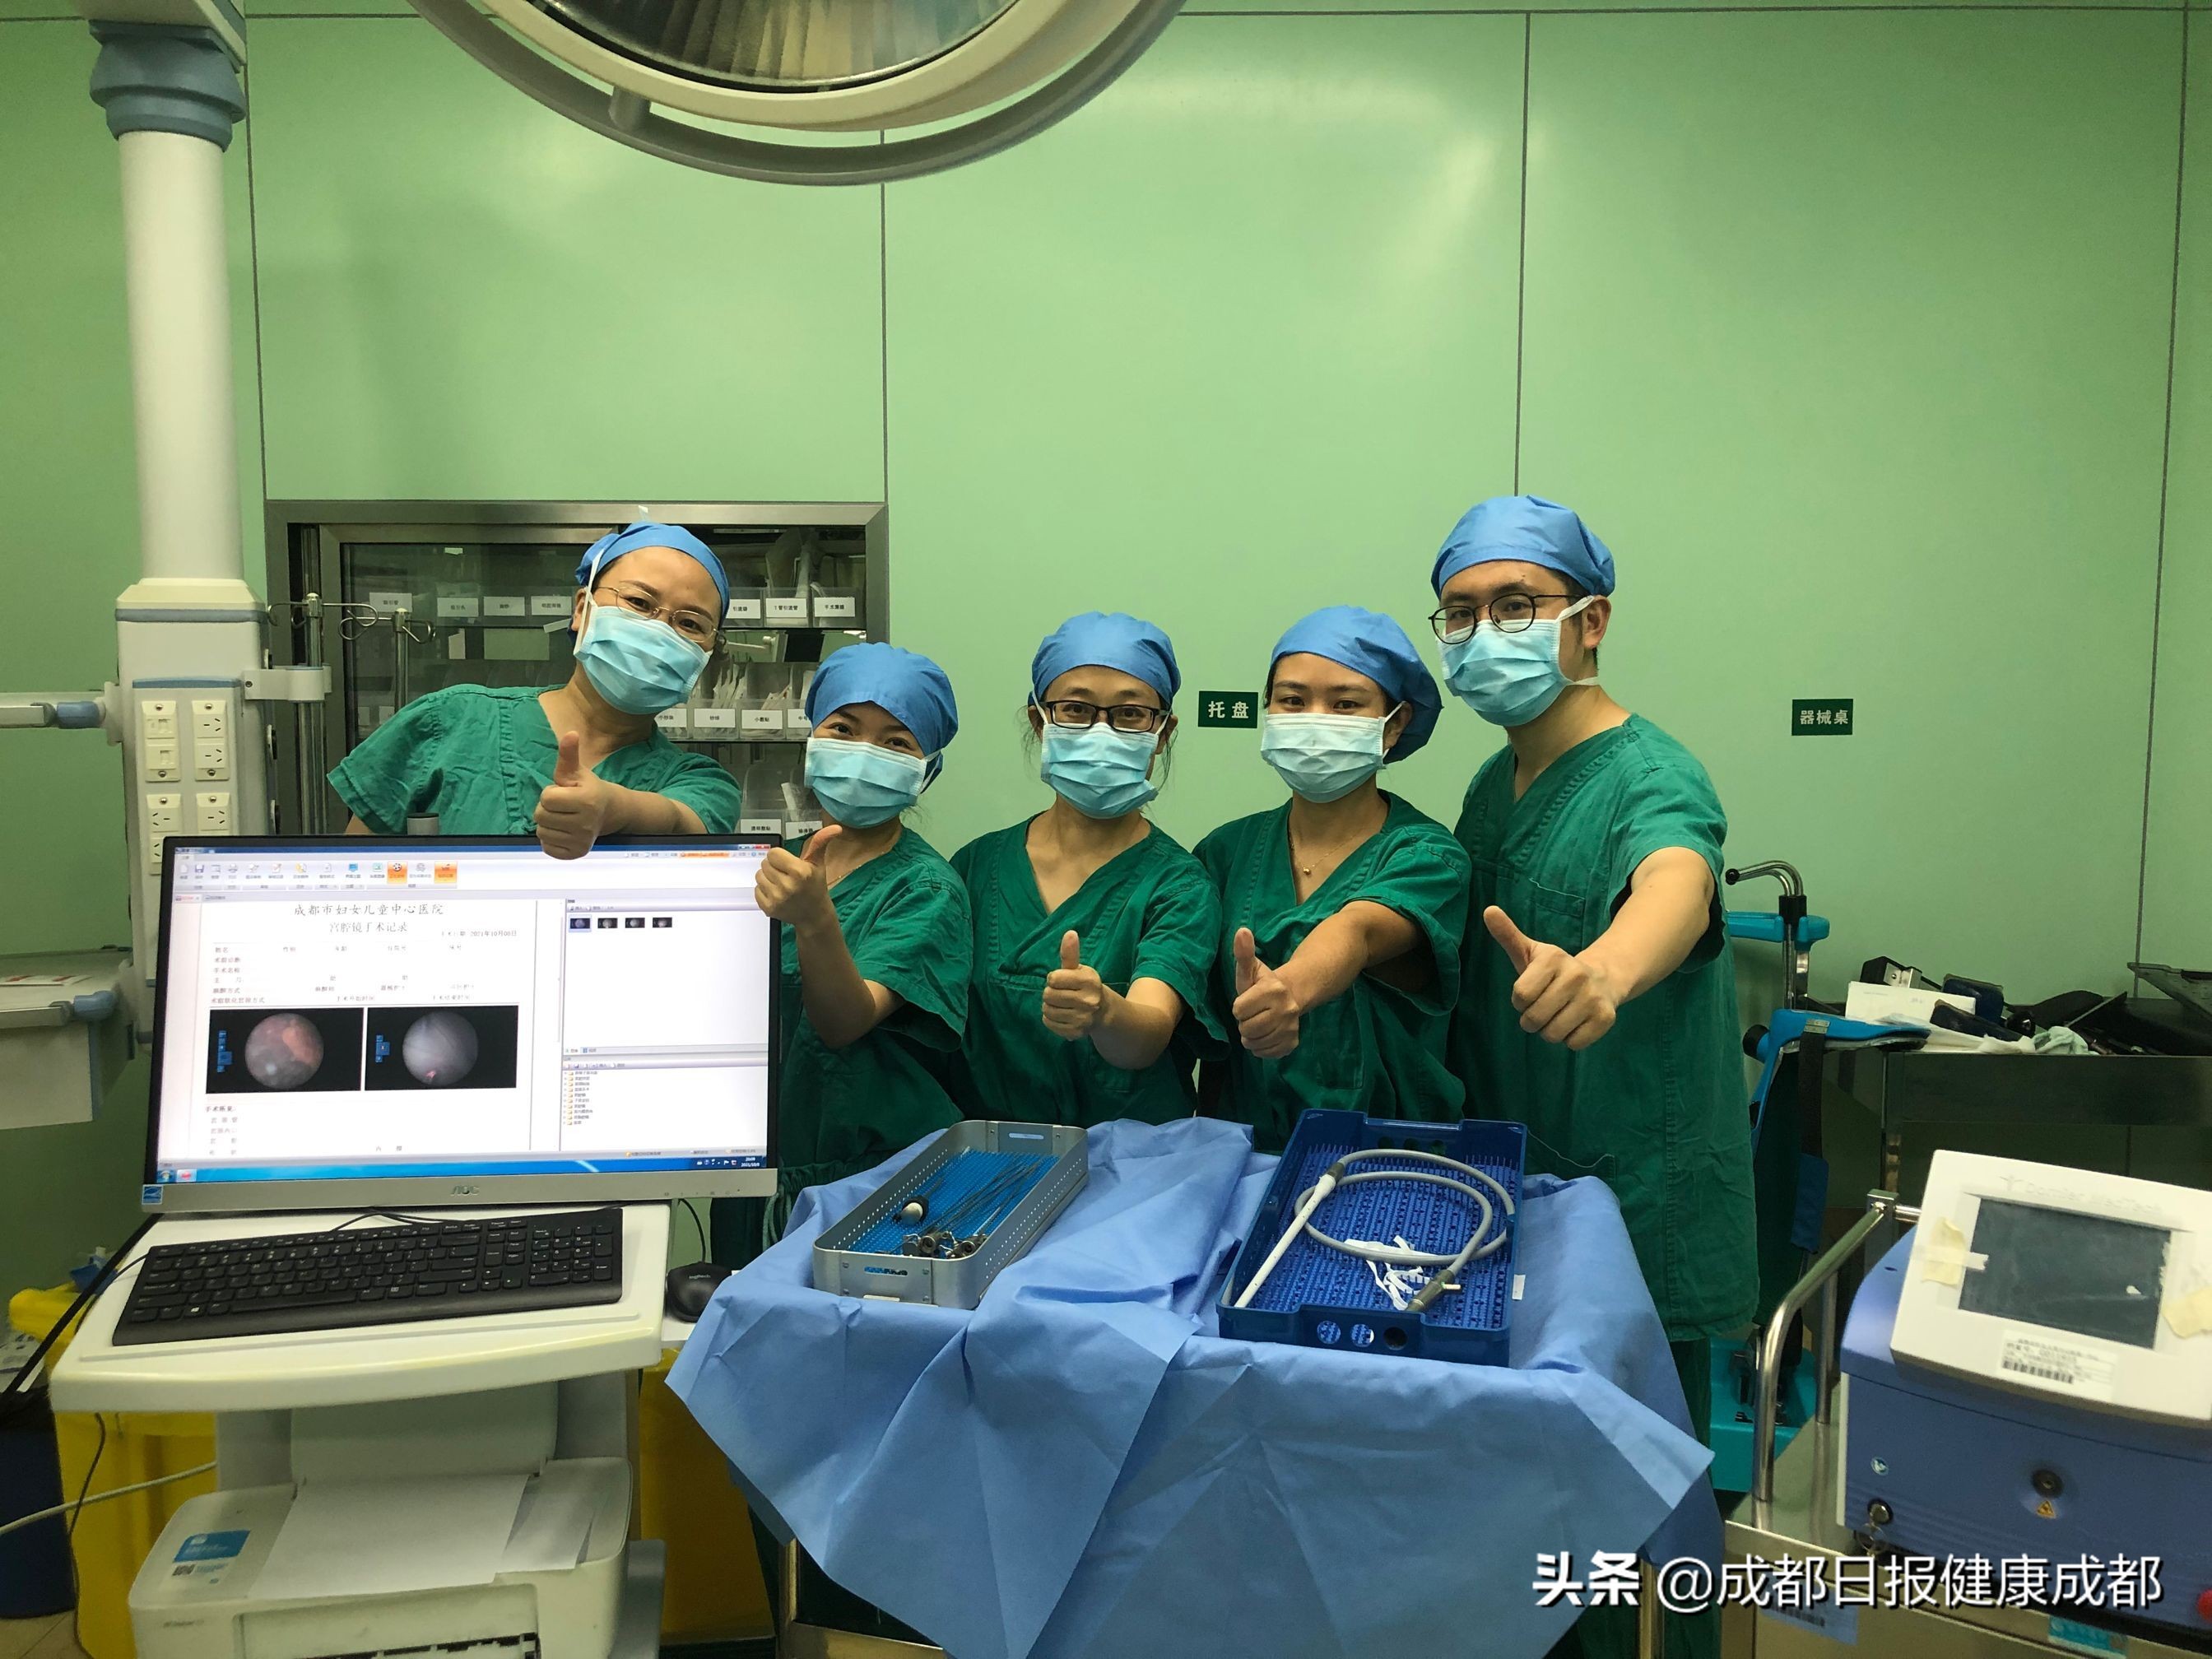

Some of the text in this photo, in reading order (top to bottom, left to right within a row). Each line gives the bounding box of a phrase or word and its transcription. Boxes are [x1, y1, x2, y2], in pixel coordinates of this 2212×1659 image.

[1208, 701, 1248, 718] 托盘
[1800, 709, 1848, 725] 器械桌
[294, 904, 444, 916] 成都市妇女儿童中心医院
[451, 1185, 480, 1197] AOC
